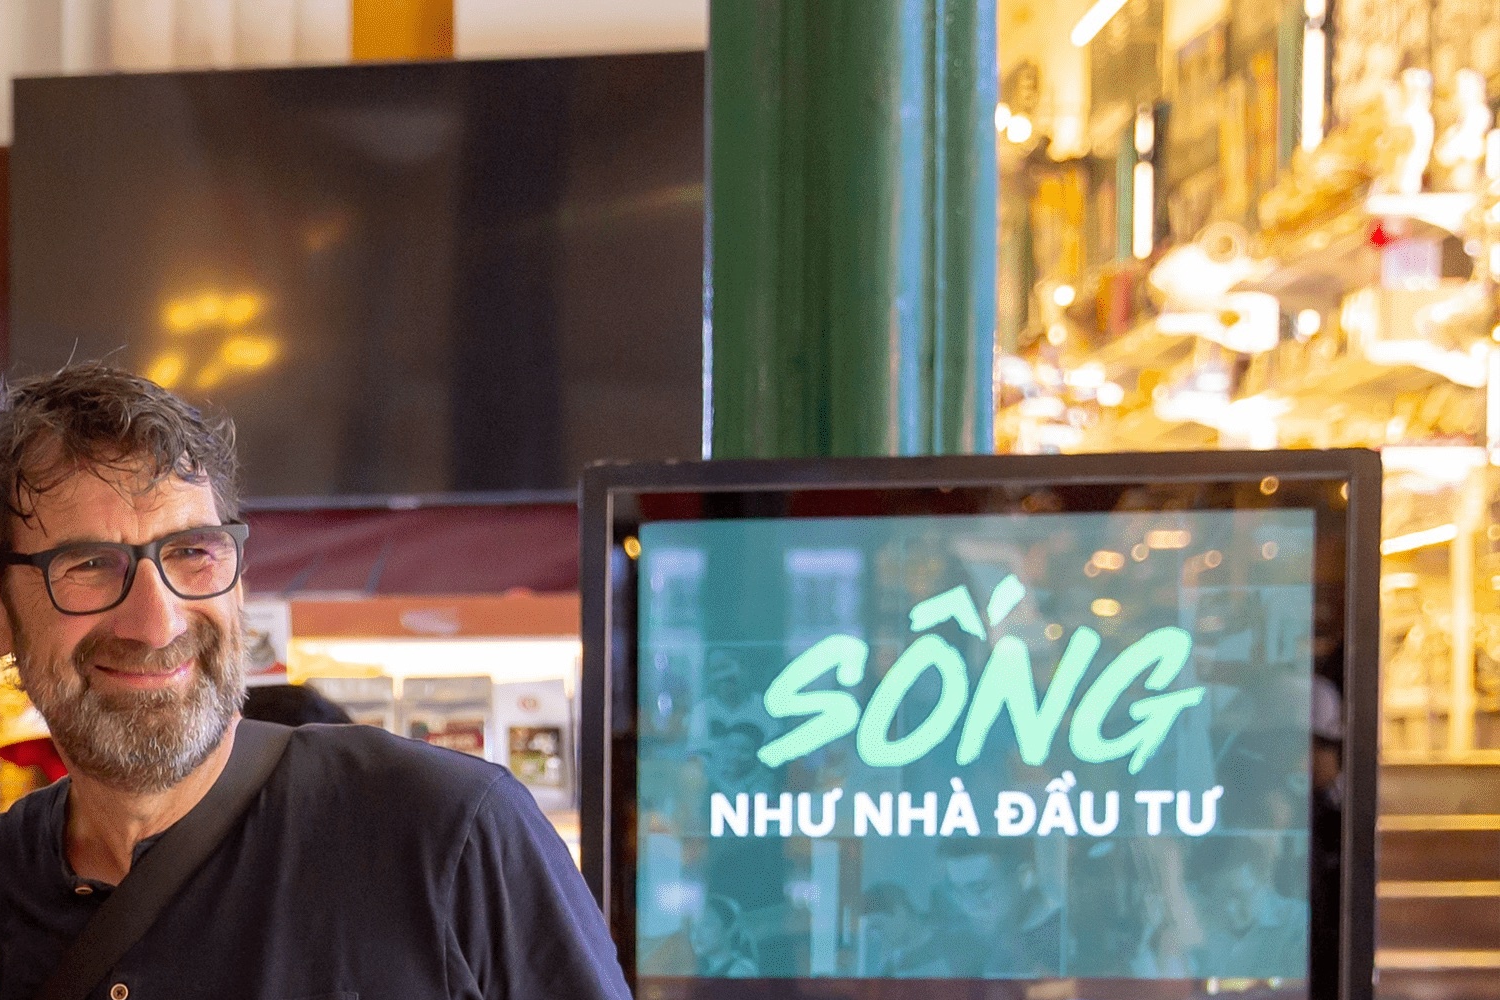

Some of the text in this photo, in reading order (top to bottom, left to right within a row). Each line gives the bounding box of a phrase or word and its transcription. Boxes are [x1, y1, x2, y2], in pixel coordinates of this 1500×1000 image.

[757, 574, 1207, 775] SỐNG
[710, 769, 1225, 838] NHƯ NHÀ ĐẦU TƯ
